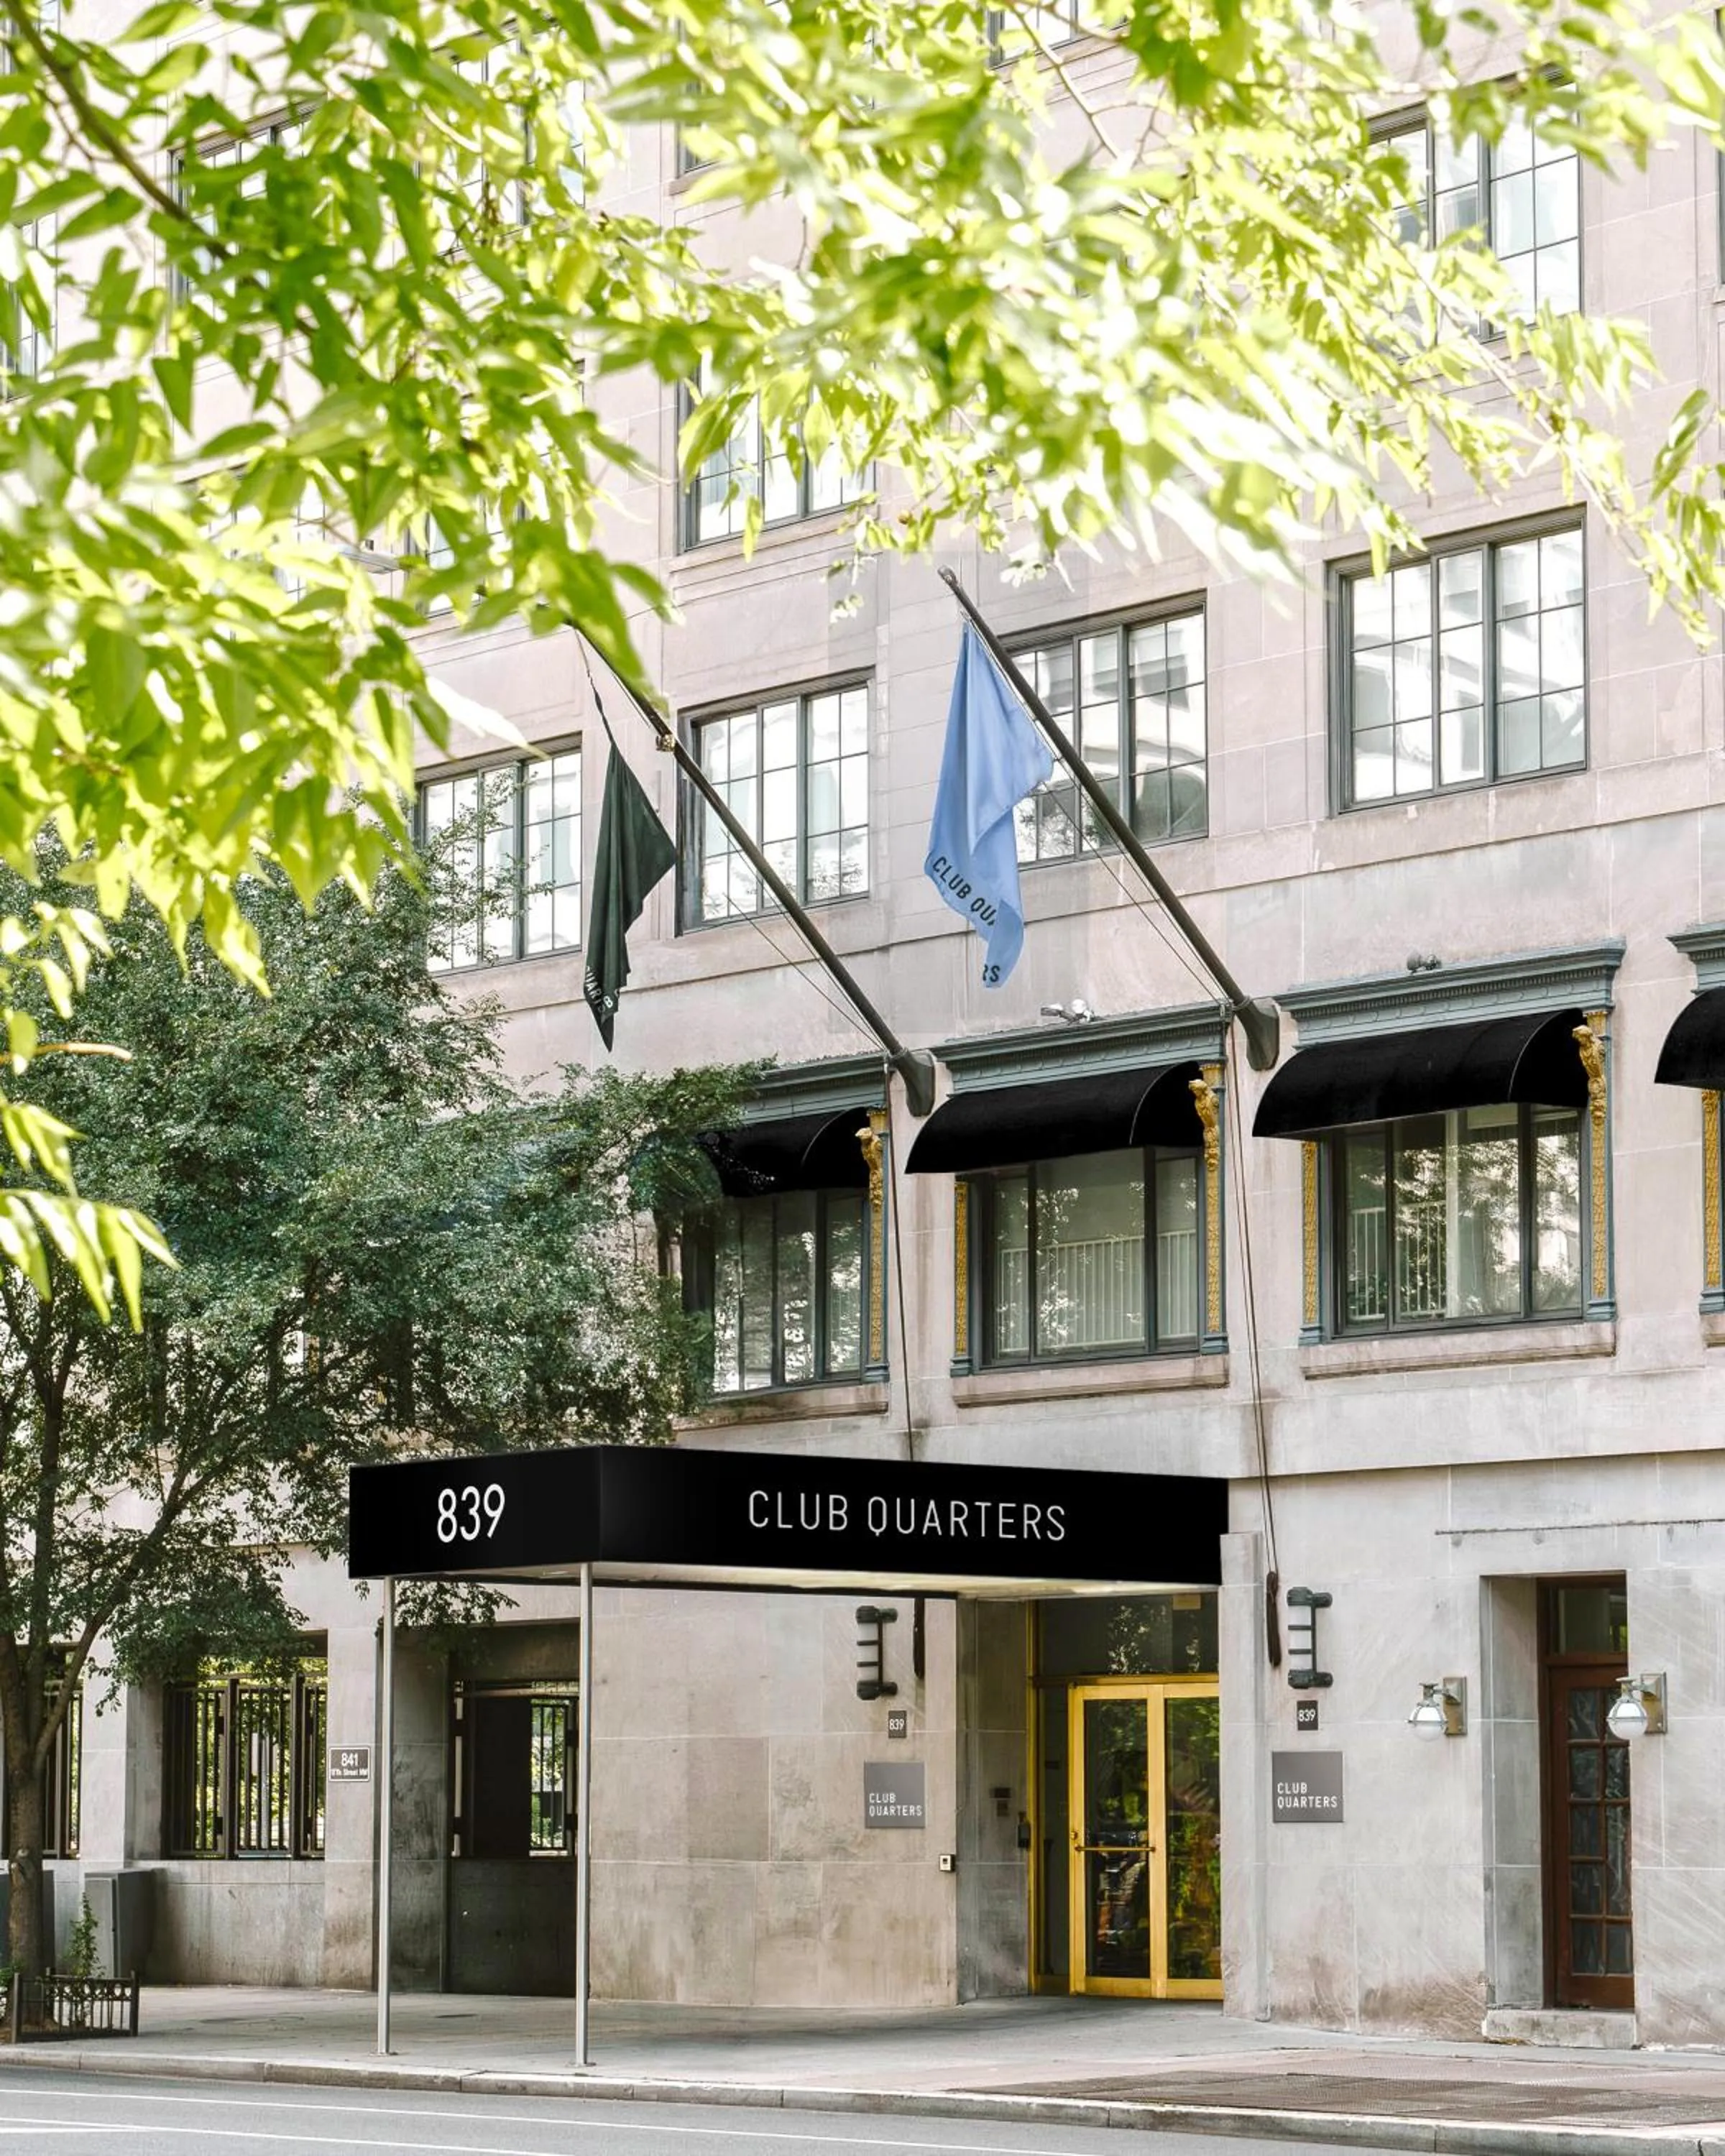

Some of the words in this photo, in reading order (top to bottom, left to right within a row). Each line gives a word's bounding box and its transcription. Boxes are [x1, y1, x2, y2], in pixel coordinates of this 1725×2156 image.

[932, 856, 972, 899] CLUB
[970, 898, 998, 926] QU
[436, 1483, 505, 1543] 839
[749, 1490, 847, 1531] CLUB
[868, 1496, 1065, 1541] QUARTERS
[1298, 1709, 1316, 1722] 839
[888, 1718, 905, 1731] 839
[341, 1752, 359, 1766] 841
[1277, 1782, 1308, 1794] CLUB
[868, 1792, 896, 1803] CLUB
[1276, 1796, 1338, 1810] QUARTERS
[868, 1805, 923, 1818] QUARTERS
